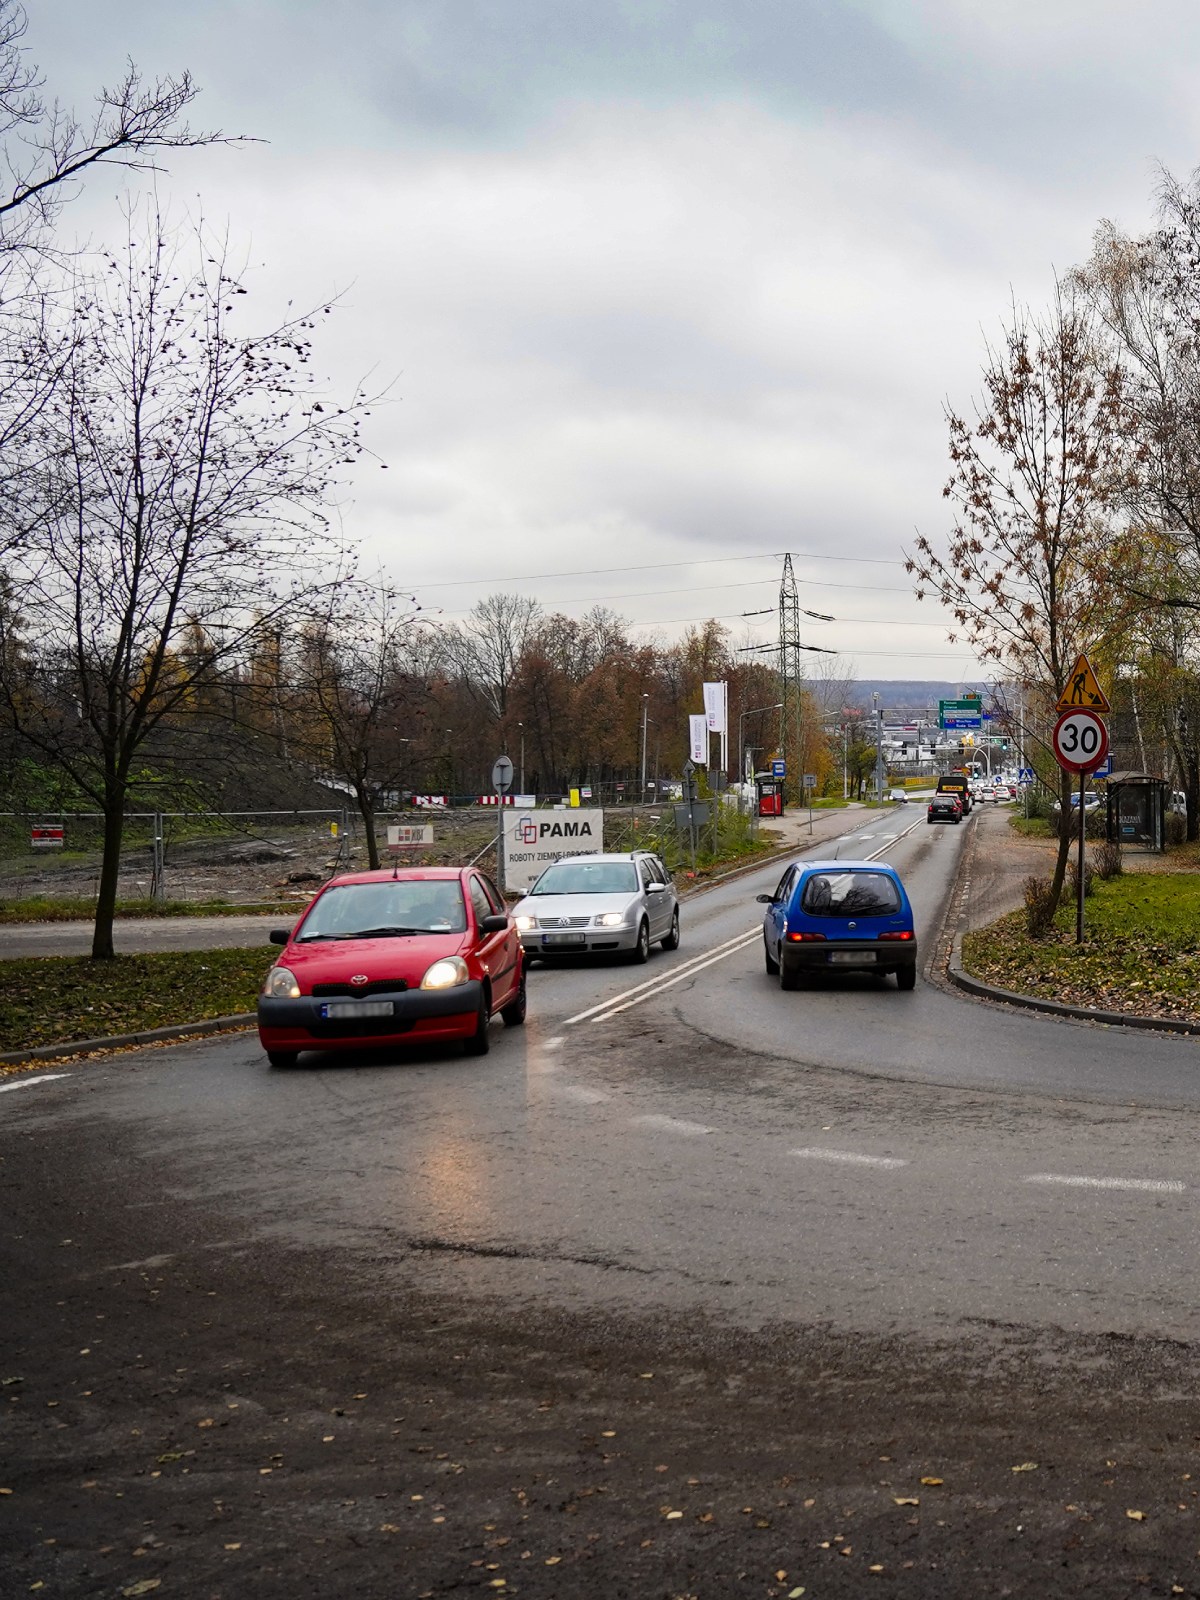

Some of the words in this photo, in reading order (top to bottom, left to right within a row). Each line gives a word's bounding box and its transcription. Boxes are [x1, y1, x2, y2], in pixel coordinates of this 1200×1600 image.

[1062, 723, 1098, 754] 30
[540, 822, 592, 838] PAMA
[509, 852, 535, 862] ROBOTY
[537, 851, 562, 861] ZIEMNE
